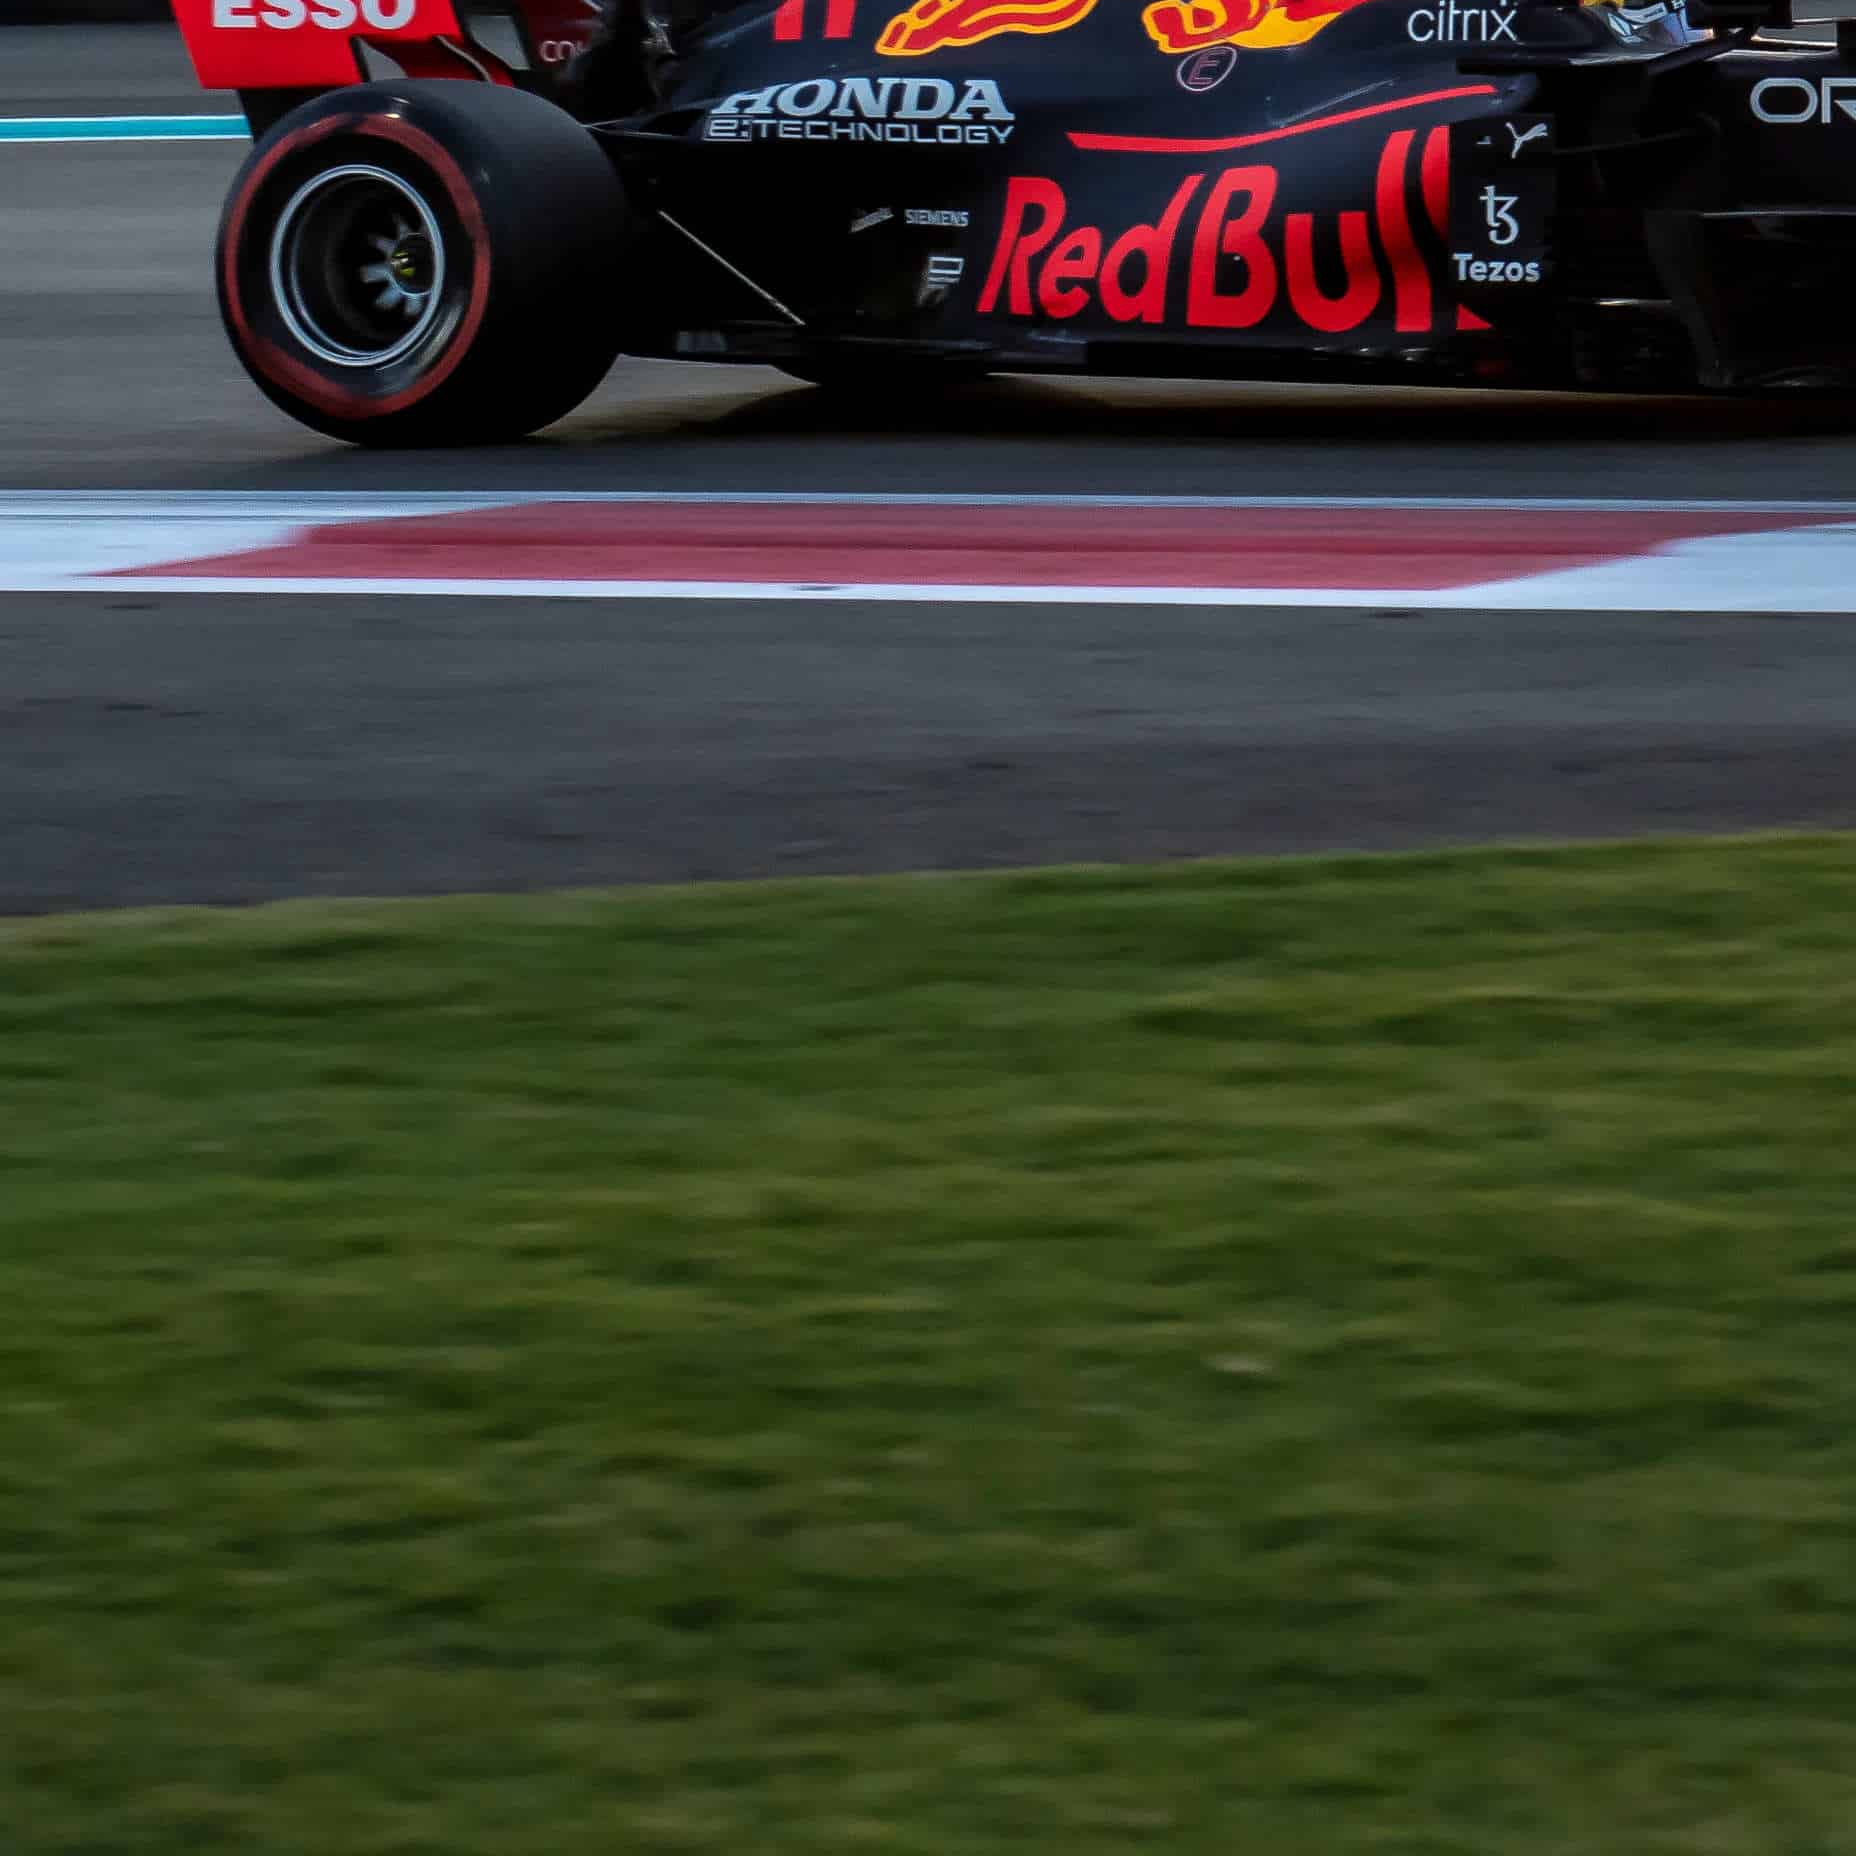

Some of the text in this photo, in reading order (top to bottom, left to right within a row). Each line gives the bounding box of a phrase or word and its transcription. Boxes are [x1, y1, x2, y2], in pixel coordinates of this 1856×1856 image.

[1407, 0, 1518, 42] citrix
[710, 76, 1016, 121] HONDA
[904, 208, 969, 228] SIEMENS
[1452, 252, 1541, 283] Tezos
